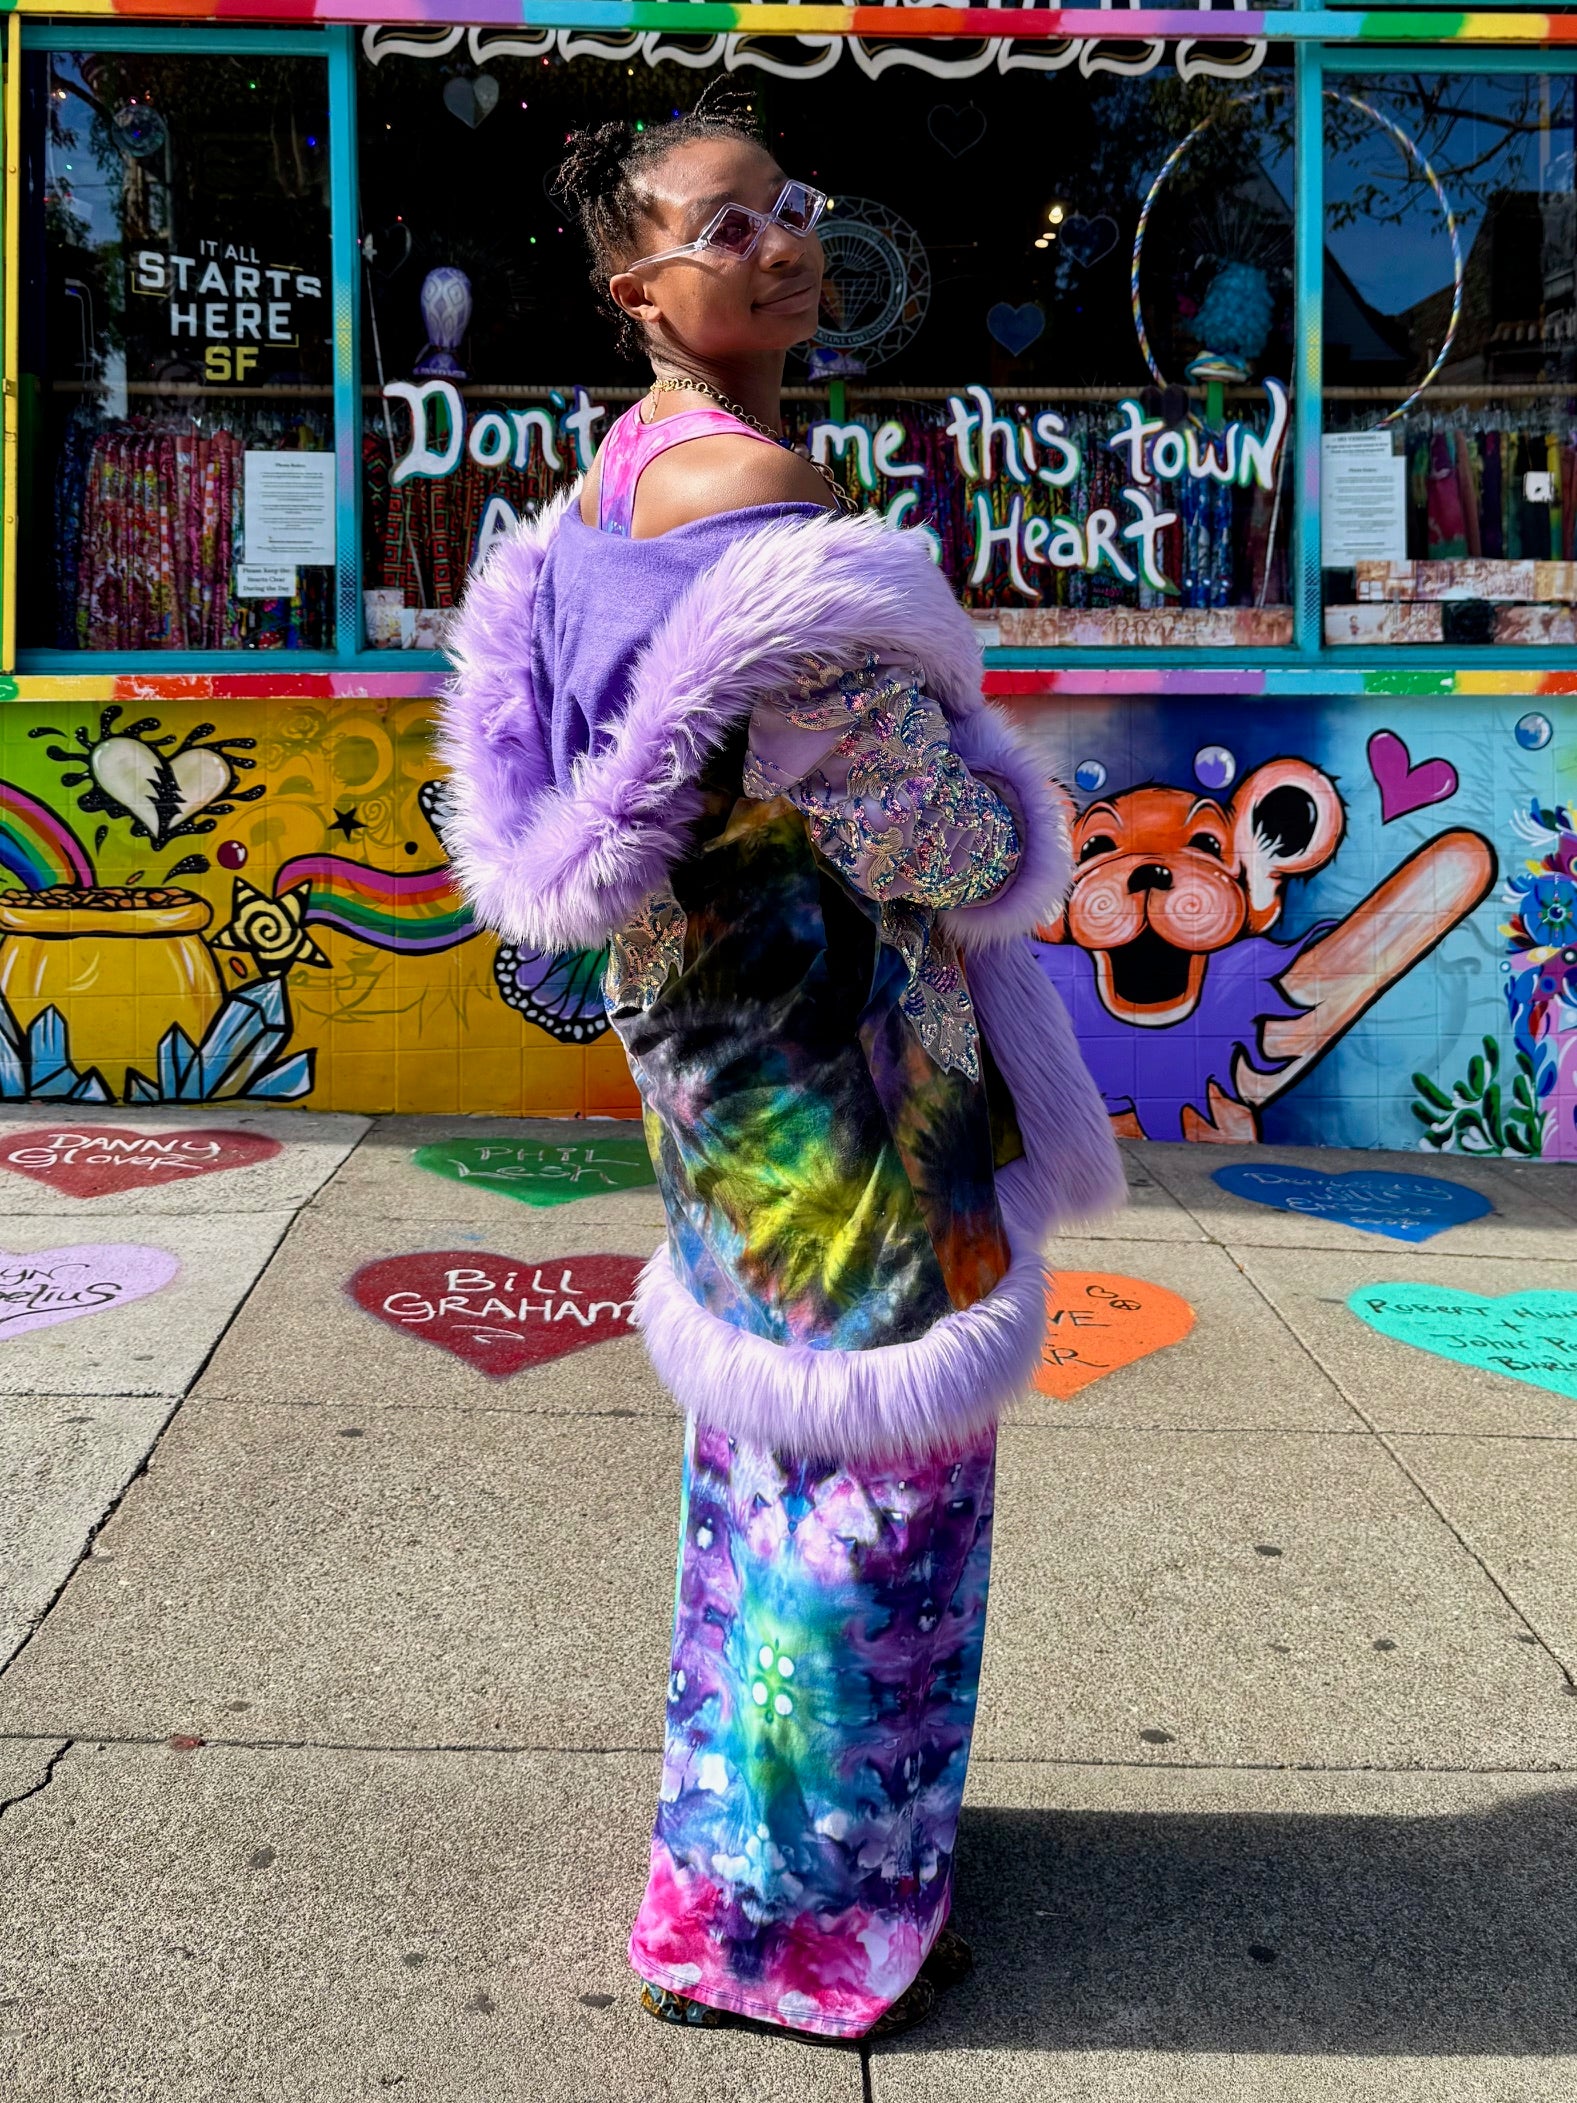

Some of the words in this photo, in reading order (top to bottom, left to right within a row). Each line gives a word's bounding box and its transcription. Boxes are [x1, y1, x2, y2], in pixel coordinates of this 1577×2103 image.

[200, 240, 218, 256] IT
[225, 245, 260, 264] ALL
[139, 250, 322, 298] STARTS
[170, 302, 292, 340] HERE
[205, 346, 259, 381] SF
[381, 378, 607, 488] Don't
[946, 382, 1081, 488] this
[48, 1133, 221, 1159] DANNY
